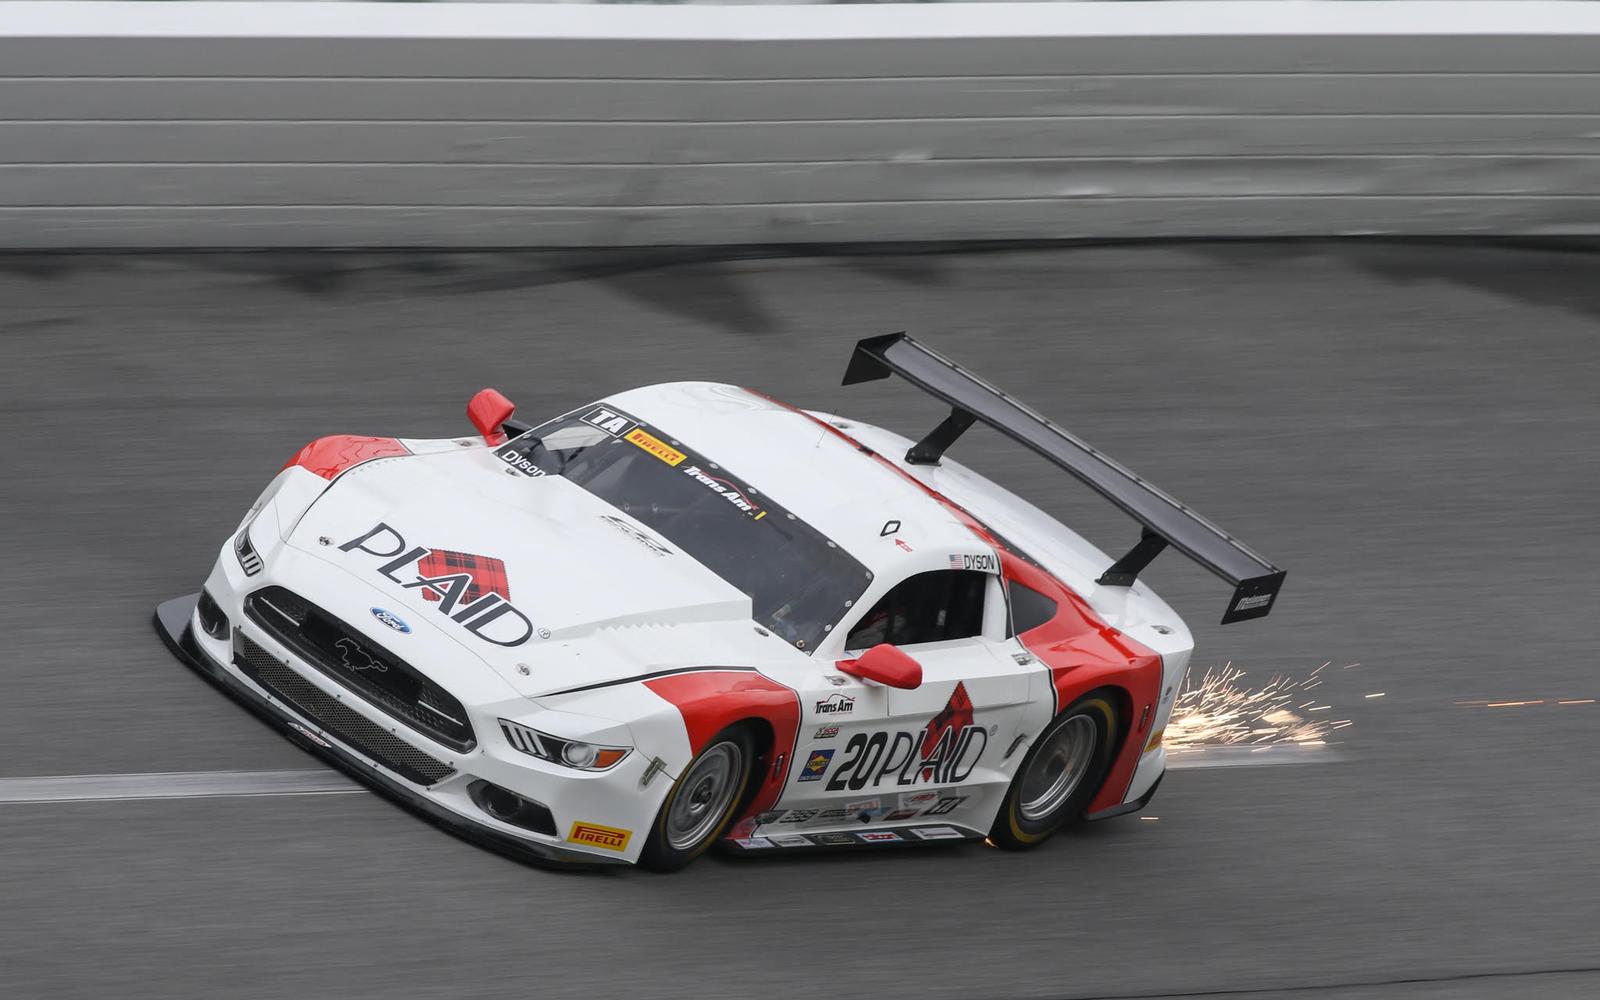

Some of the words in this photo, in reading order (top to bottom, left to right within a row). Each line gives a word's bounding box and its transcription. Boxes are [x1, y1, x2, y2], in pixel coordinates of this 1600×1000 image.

[590, 410, 628, 434] TA
[501, 450, 546, 478] Dyson
[684, 466, 727, 493] Trans
[721, 492, 752, 511] Am
[963, 554, 995, 570] DYSON
[337, 522, 534, 648] PLAID
[374, 609, 408, 632] Ford
[815, 701, 837, 714] Trans
[837, 699, 854, 712] Am
[825, 732, 888, 792] 20
[873, 725, 988, 787] PLAID
[573, 825, 626, 847] PIRELLI
